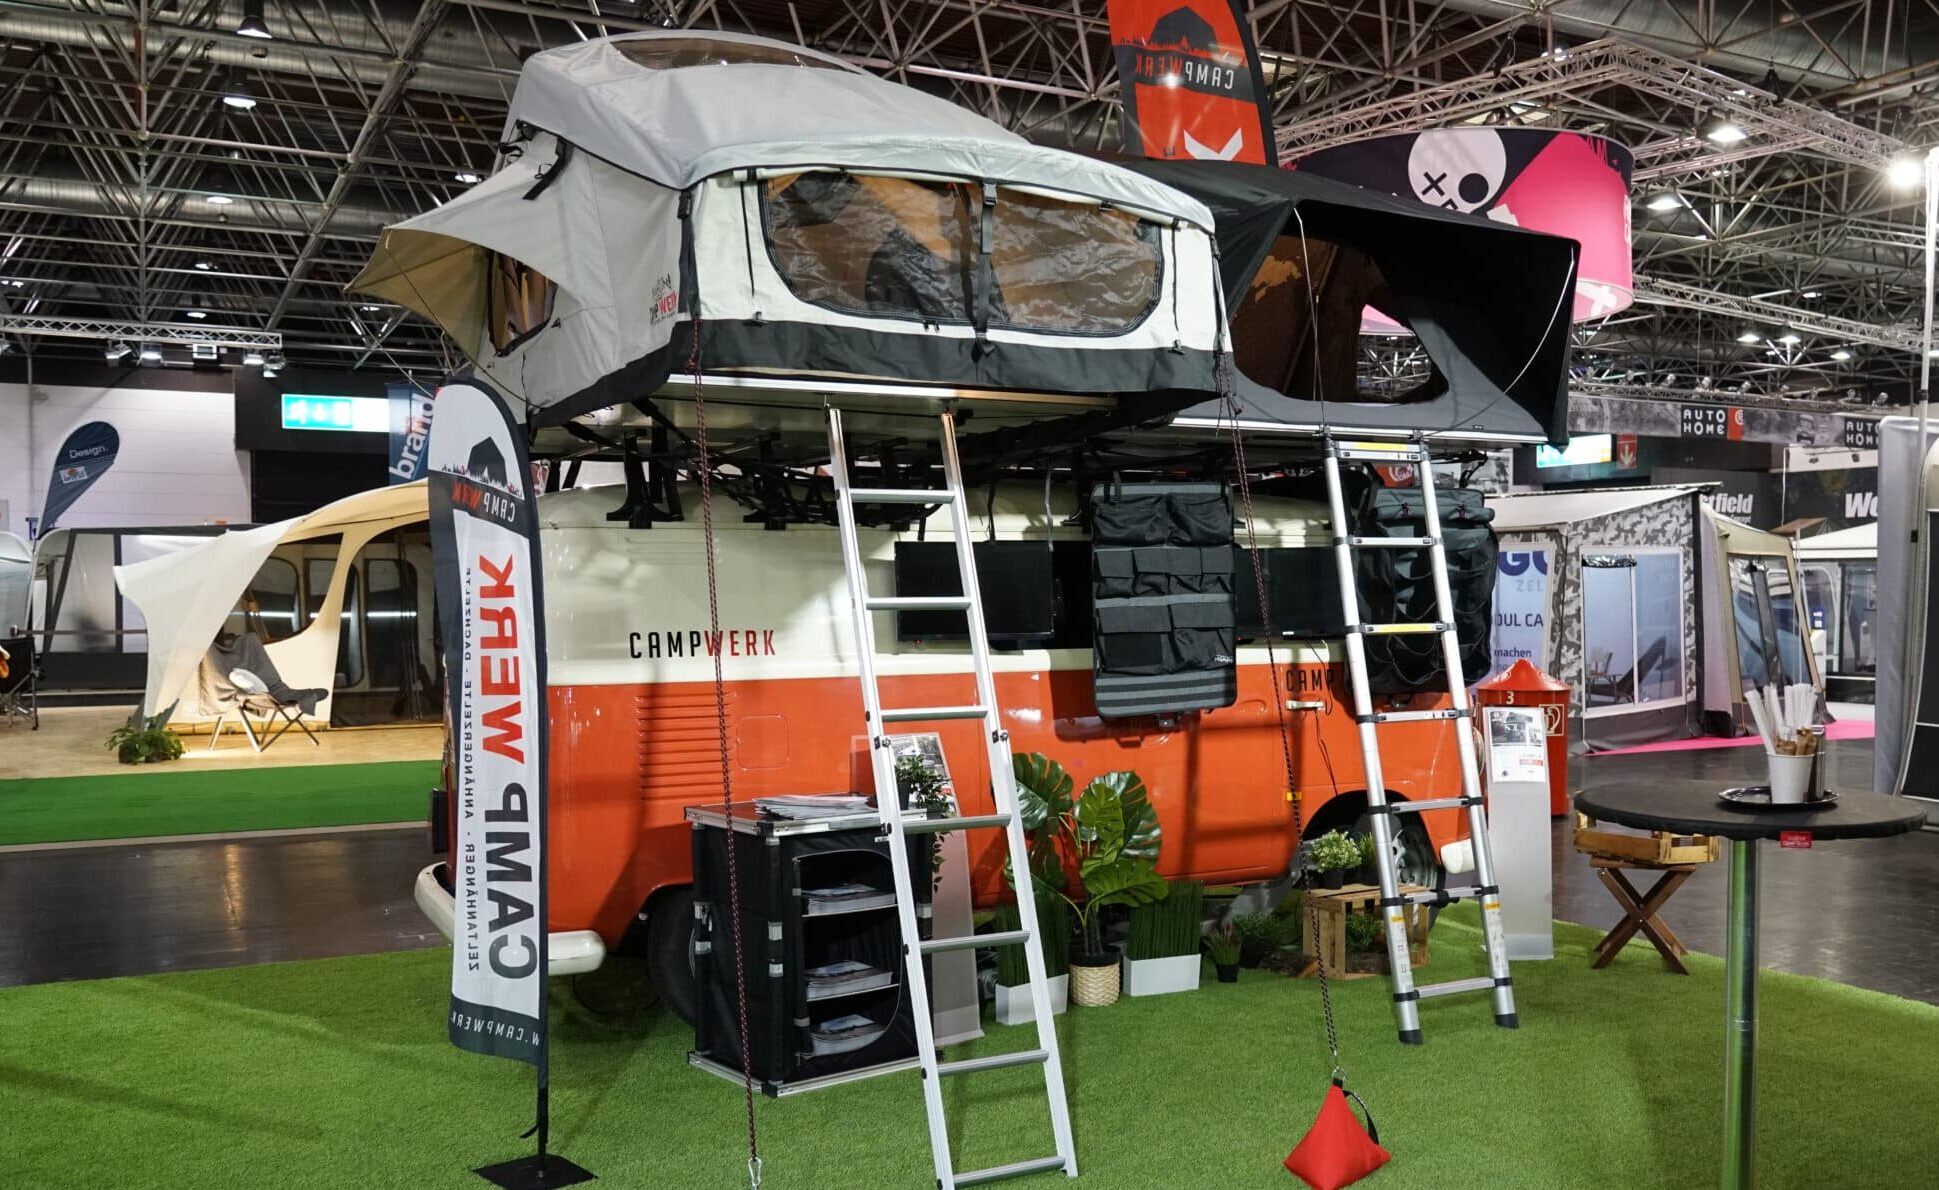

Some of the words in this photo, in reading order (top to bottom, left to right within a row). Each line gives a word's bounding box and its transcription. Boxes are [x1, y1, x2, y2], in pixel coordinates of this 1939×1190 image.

[1683, 408, 1726, 424] AUTO
[1683, 421, 1725, 436] HOME
[1846, 433, 1879, 446] HOM
[1506, 691, 1515, 705] 3
